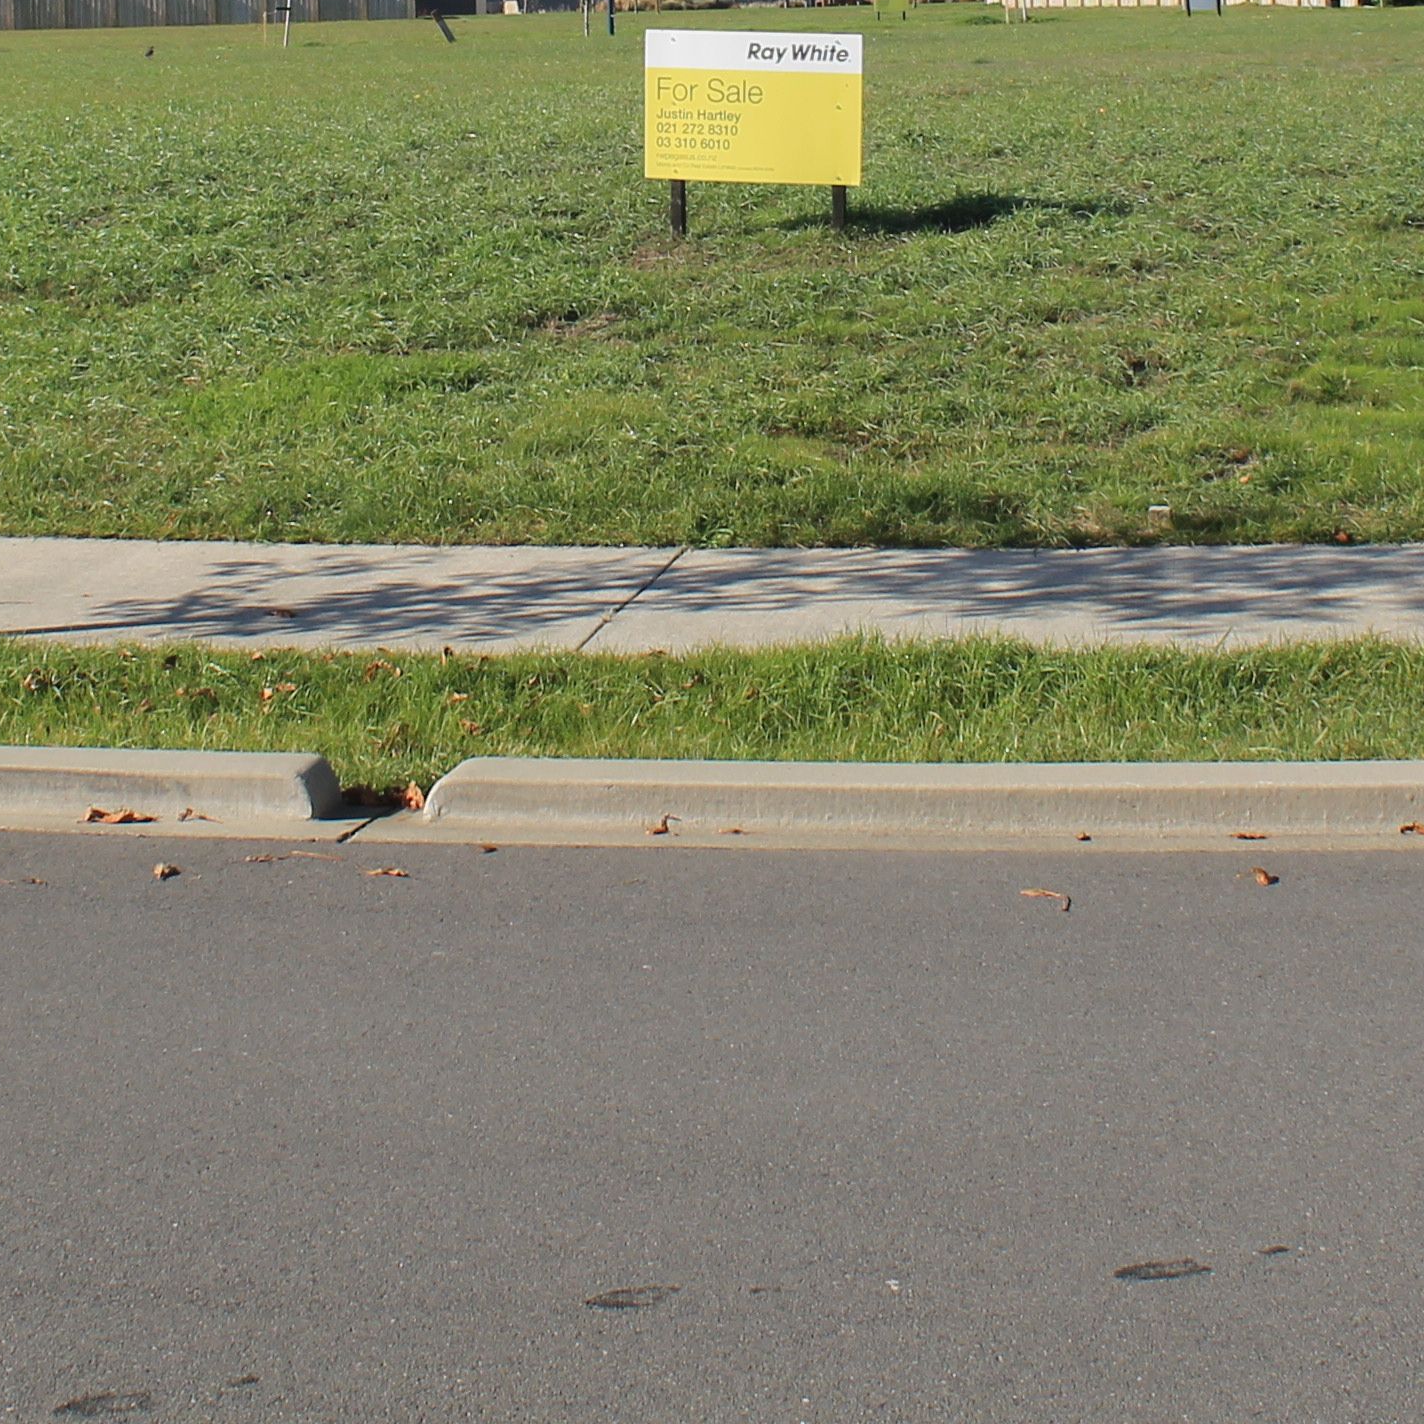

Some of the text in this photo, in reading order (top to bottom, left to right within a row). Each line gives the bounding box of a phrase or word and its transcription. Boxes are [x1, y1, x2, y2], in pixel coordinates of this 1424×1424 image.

[747, 42, 849, 64] Ray White
[657, 77, 763, 104] For Sale
[656, 108, 741, 124] Justin Hartley
[656, 122, 738, 136] 021 272 8310
[656, 136, 730, 150] 03 310 6010
